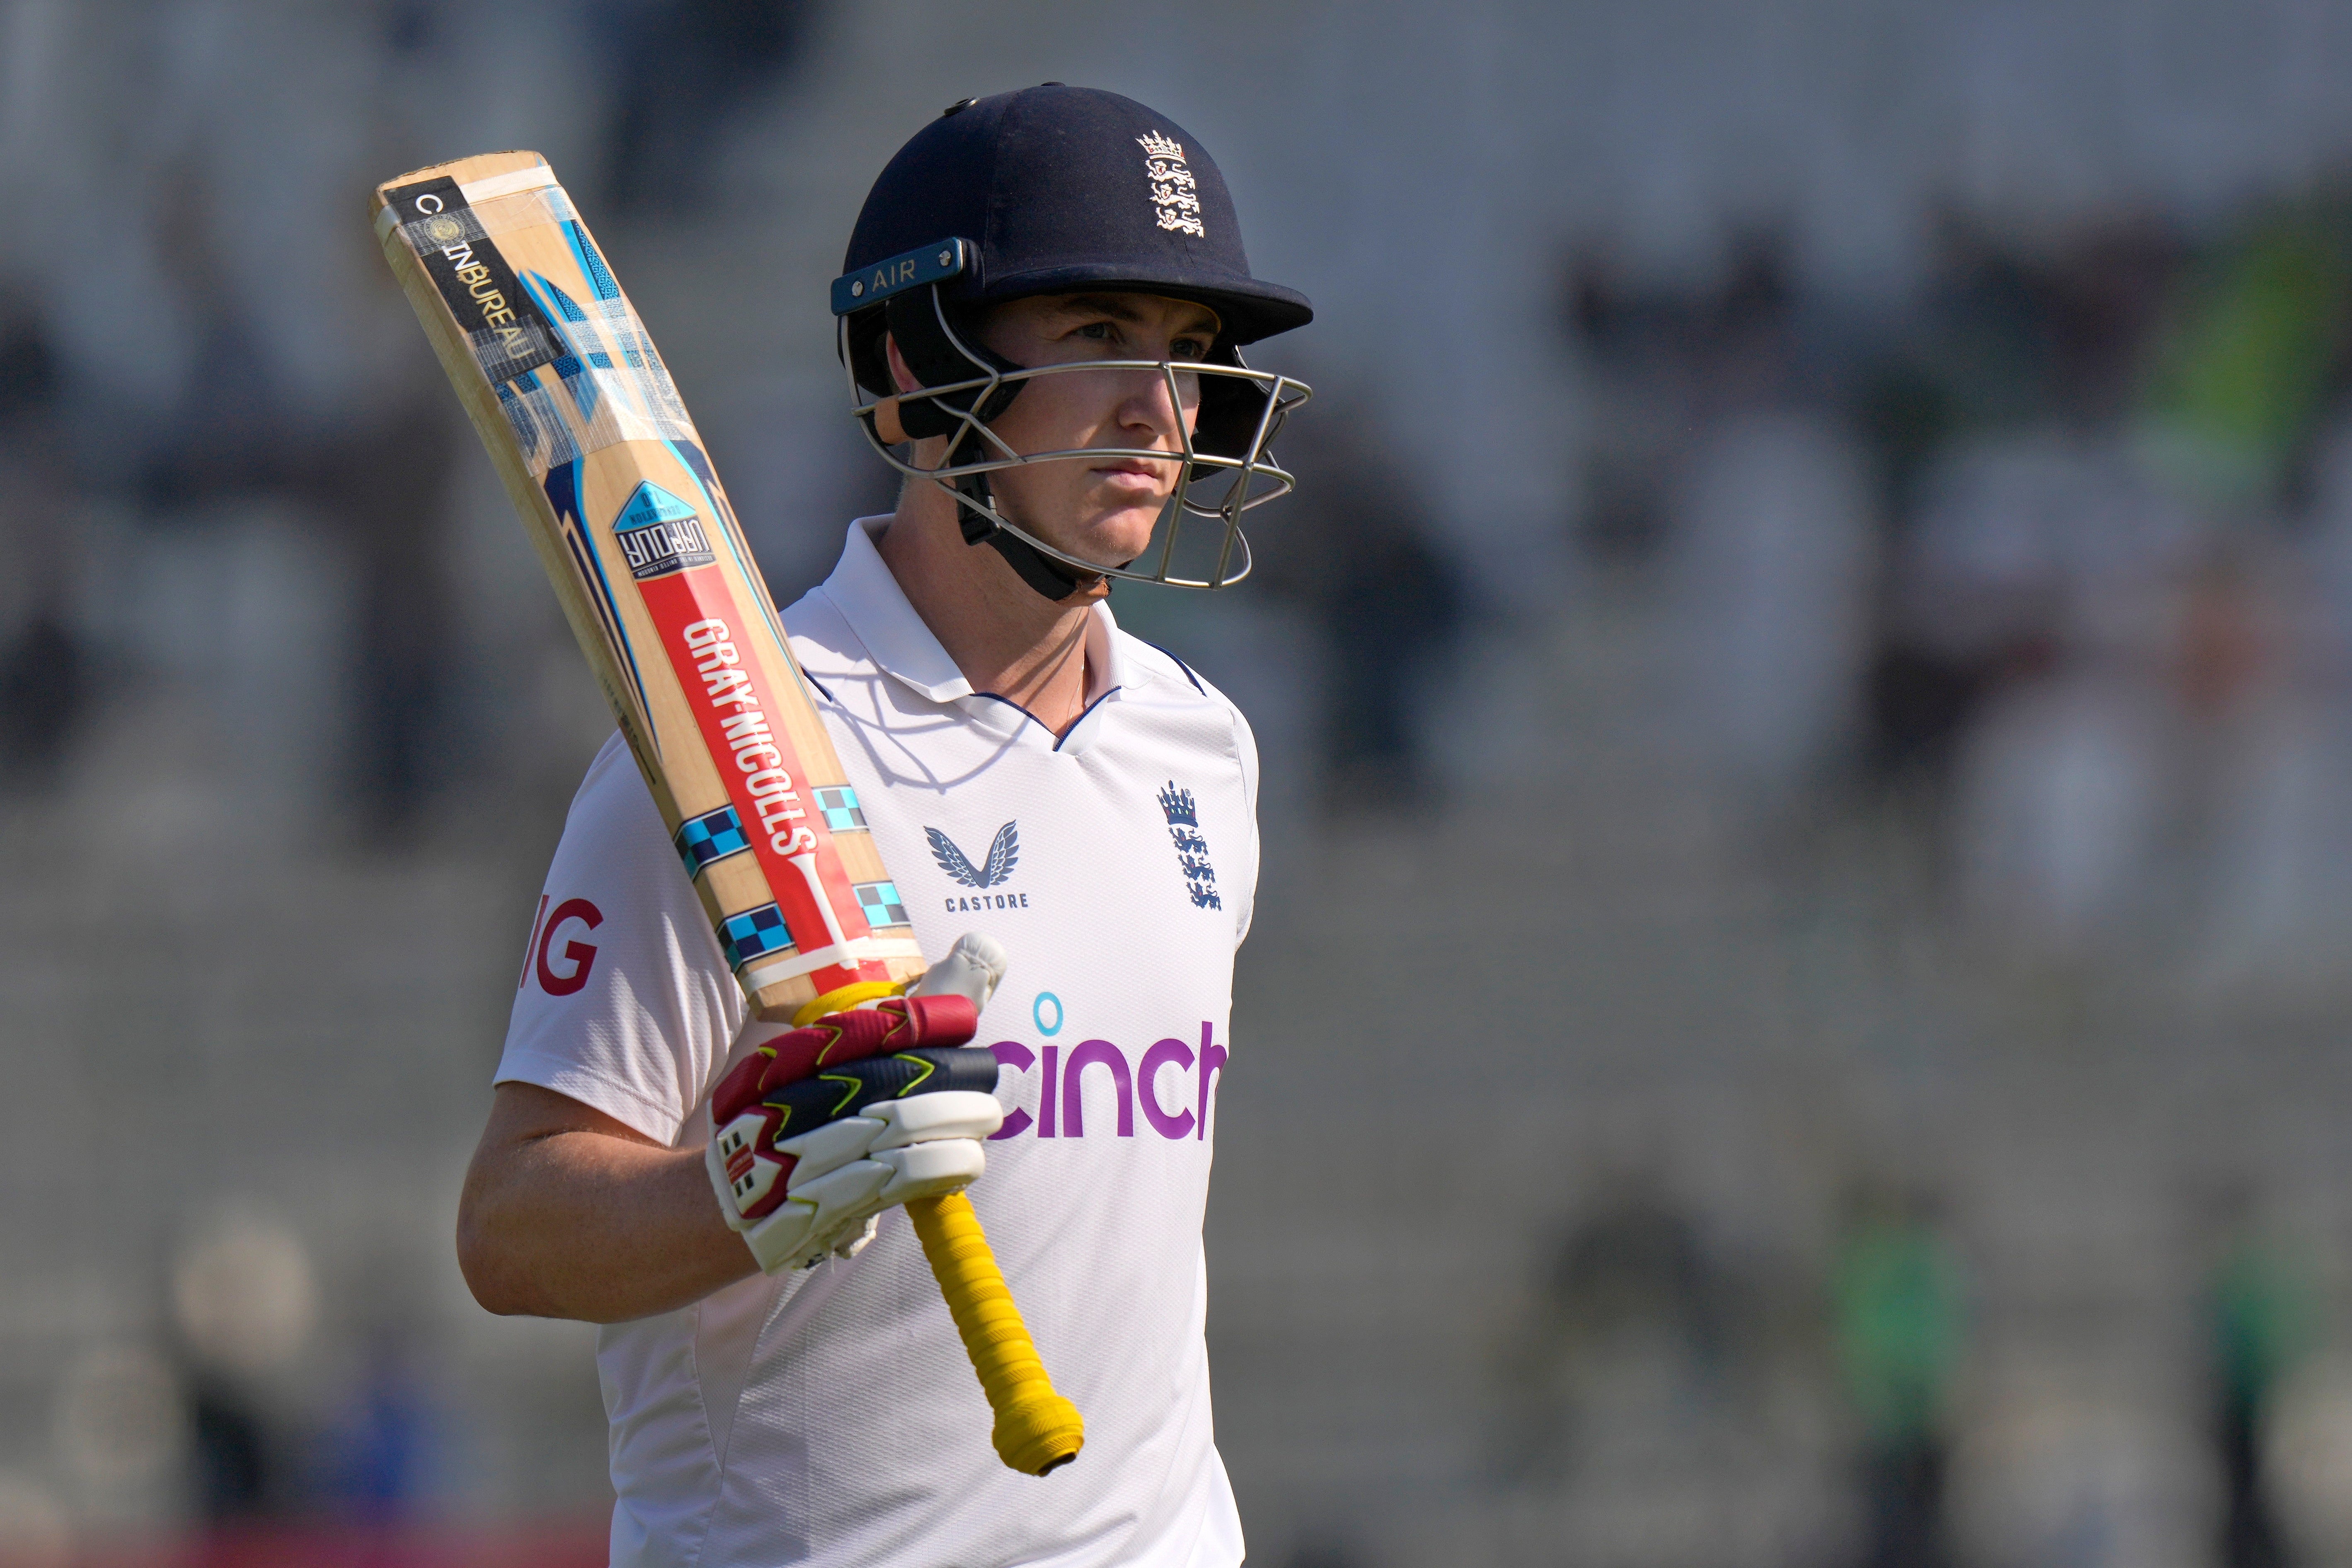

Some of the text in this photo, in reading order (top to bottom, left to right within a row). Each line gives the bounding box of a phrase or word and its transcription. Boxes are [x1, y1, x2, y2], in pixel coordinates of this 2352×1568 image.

[872, 259, 915, 292] AIR
[683, 617, 818, 856] GRAY-NICOLLS
[945, 892, 1029, 912] CASTORE
[520, 894, 604, 996] IG
